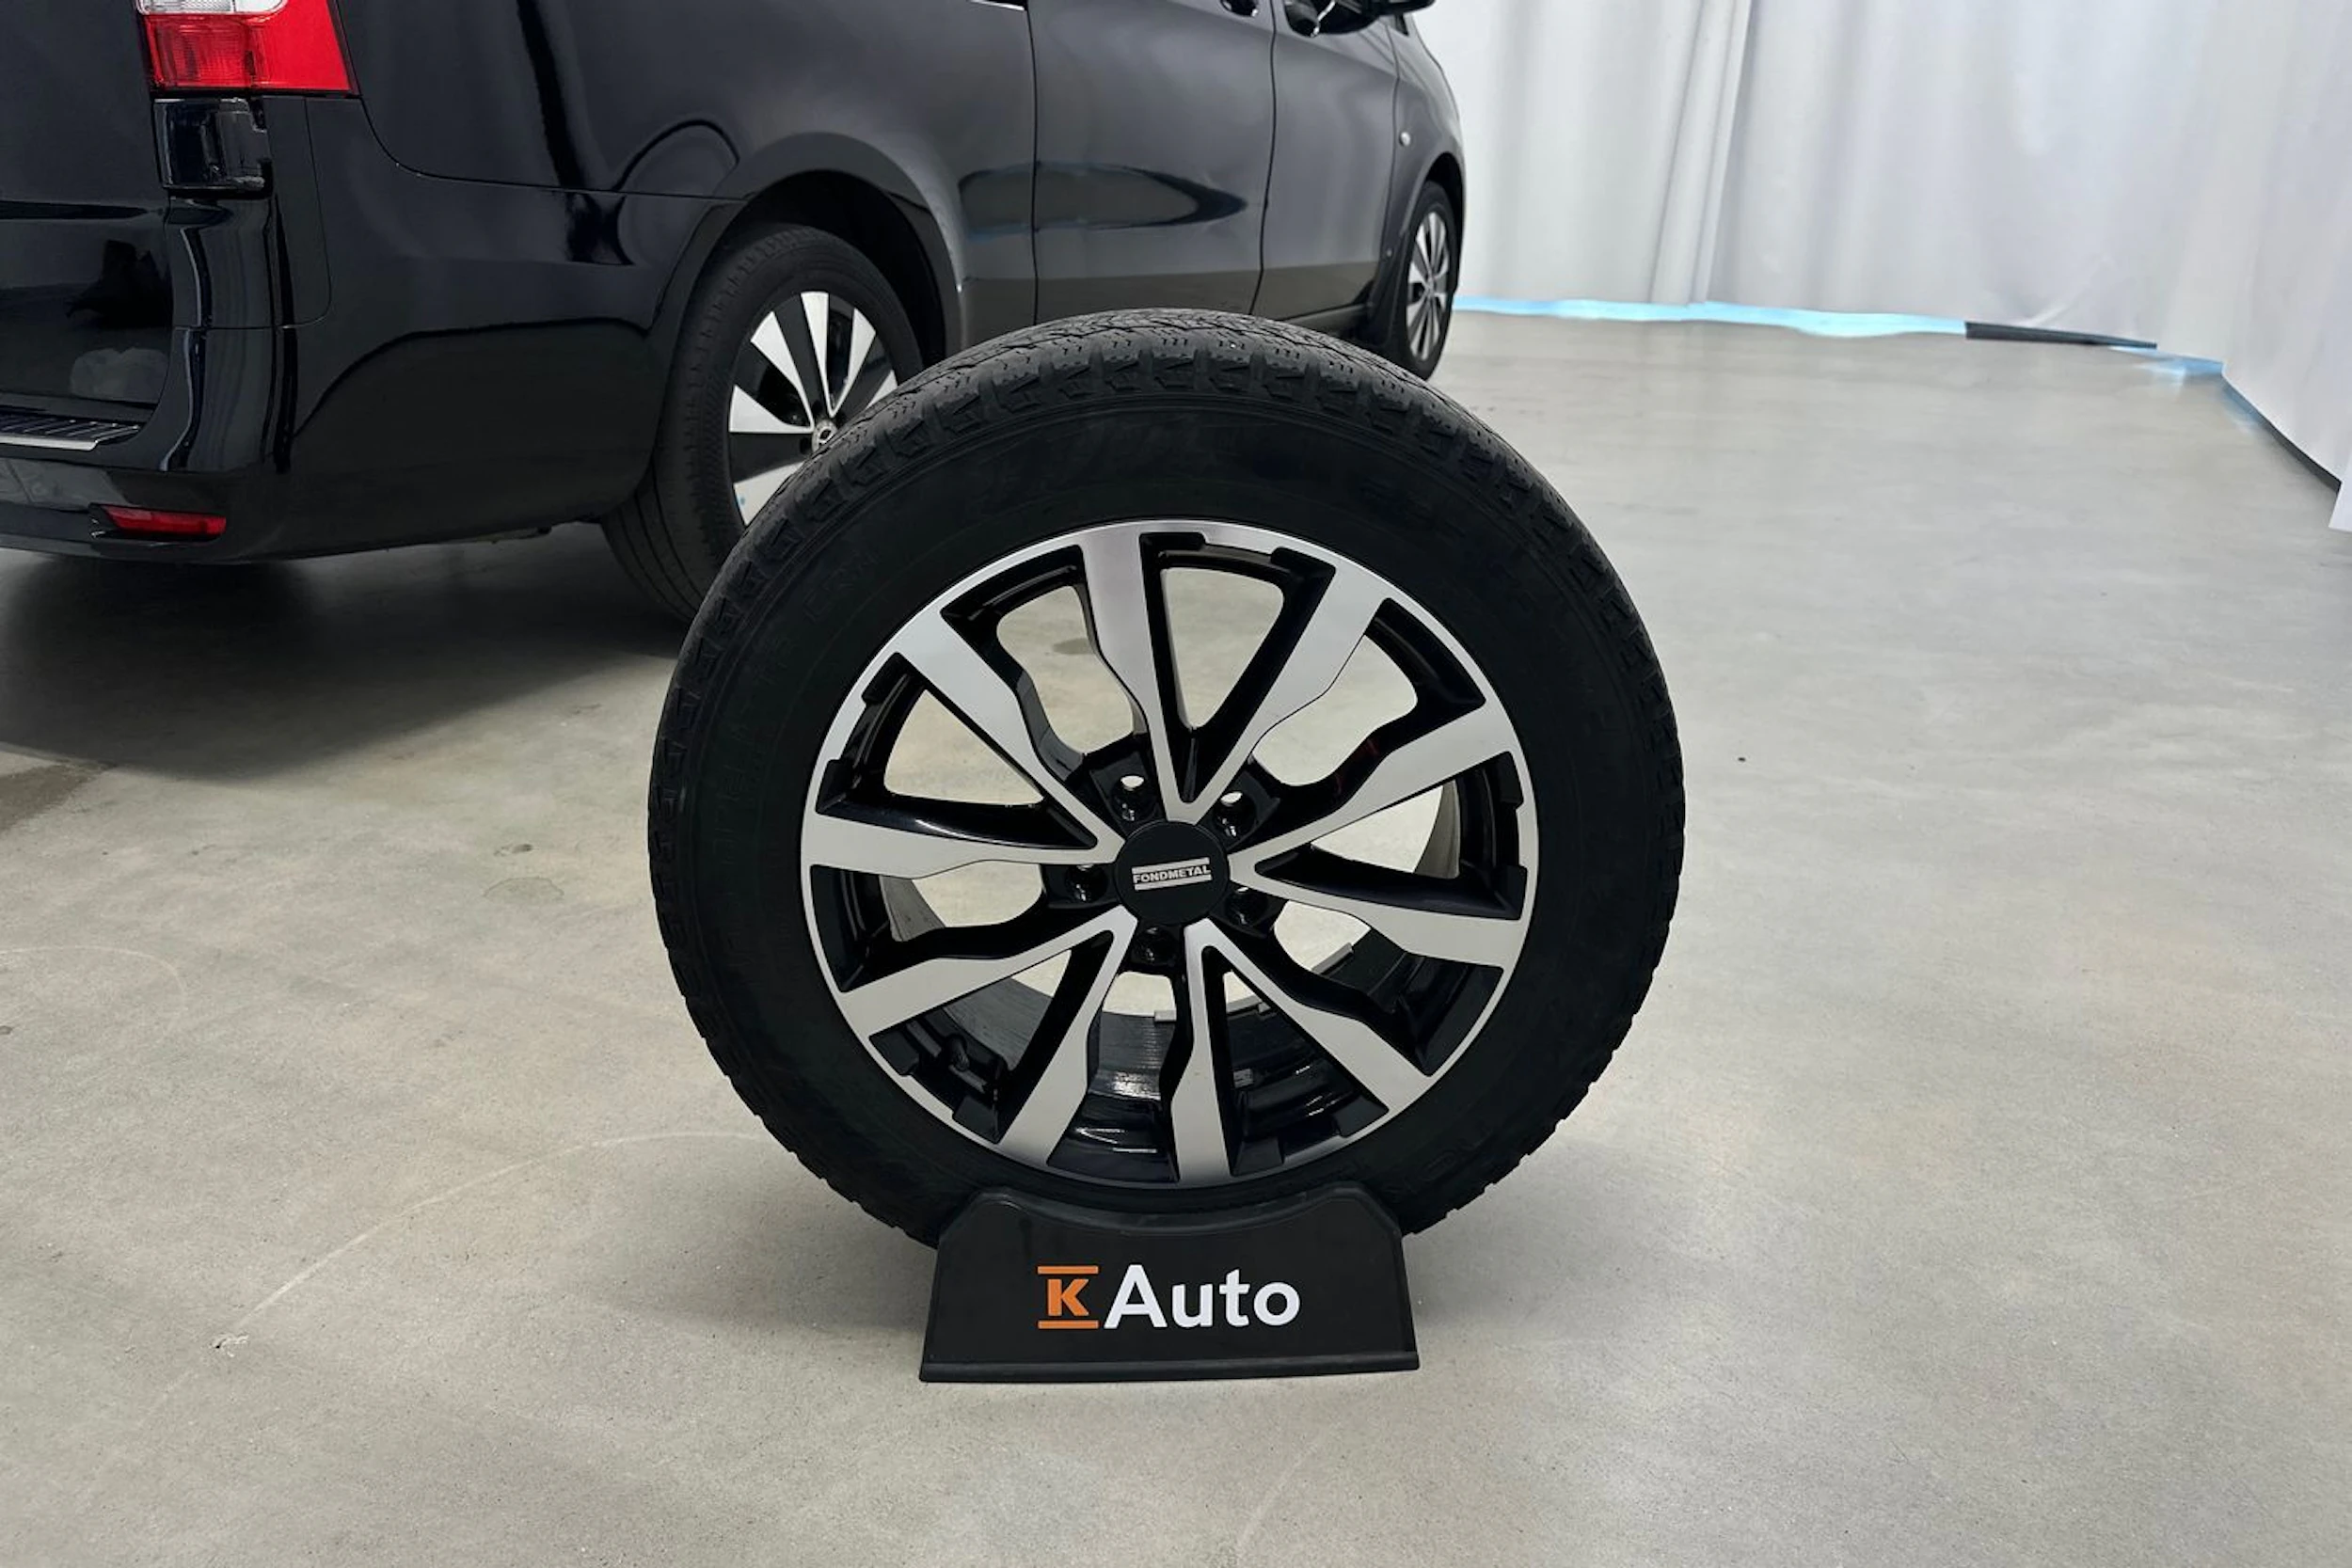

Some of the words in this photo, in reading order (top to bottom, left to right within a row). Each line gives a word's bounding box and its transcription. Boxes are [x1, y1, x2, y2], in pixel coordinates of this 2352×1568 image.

[1132, 864, 1212, 884] FONDMETAL
[1045, 1276, 1091, 1319] K
[1104, 1264, 1300, 1329] Auto
